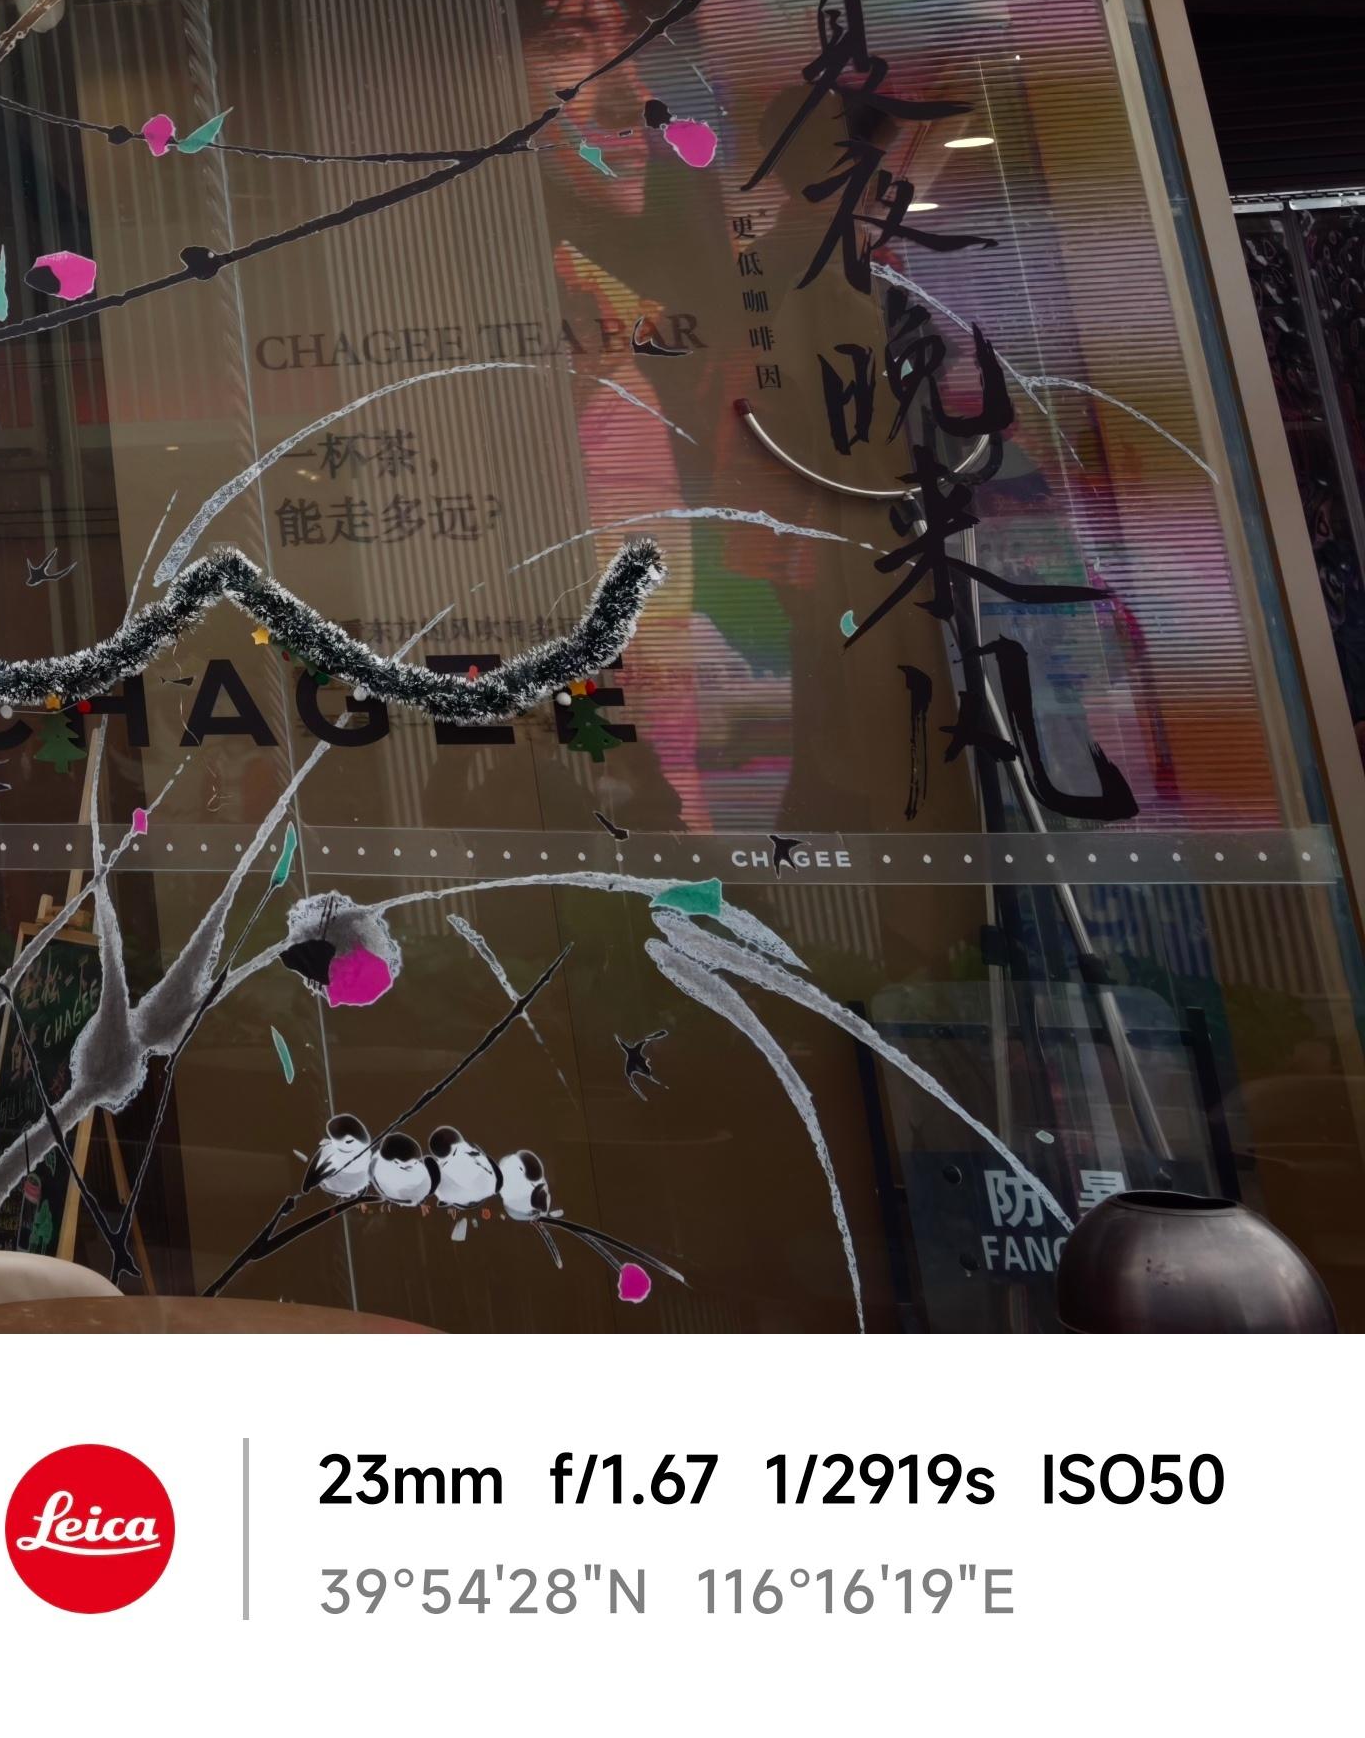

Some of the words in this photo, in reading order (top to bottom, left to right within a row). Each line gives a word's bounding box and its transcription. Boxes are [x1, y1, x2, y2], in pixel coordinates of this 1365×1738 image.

[255, 325, 461, 370] CHAGEE
[478, 318, 589, 360] TEA
[733, 215, 781, 389] 更低咖啡因
